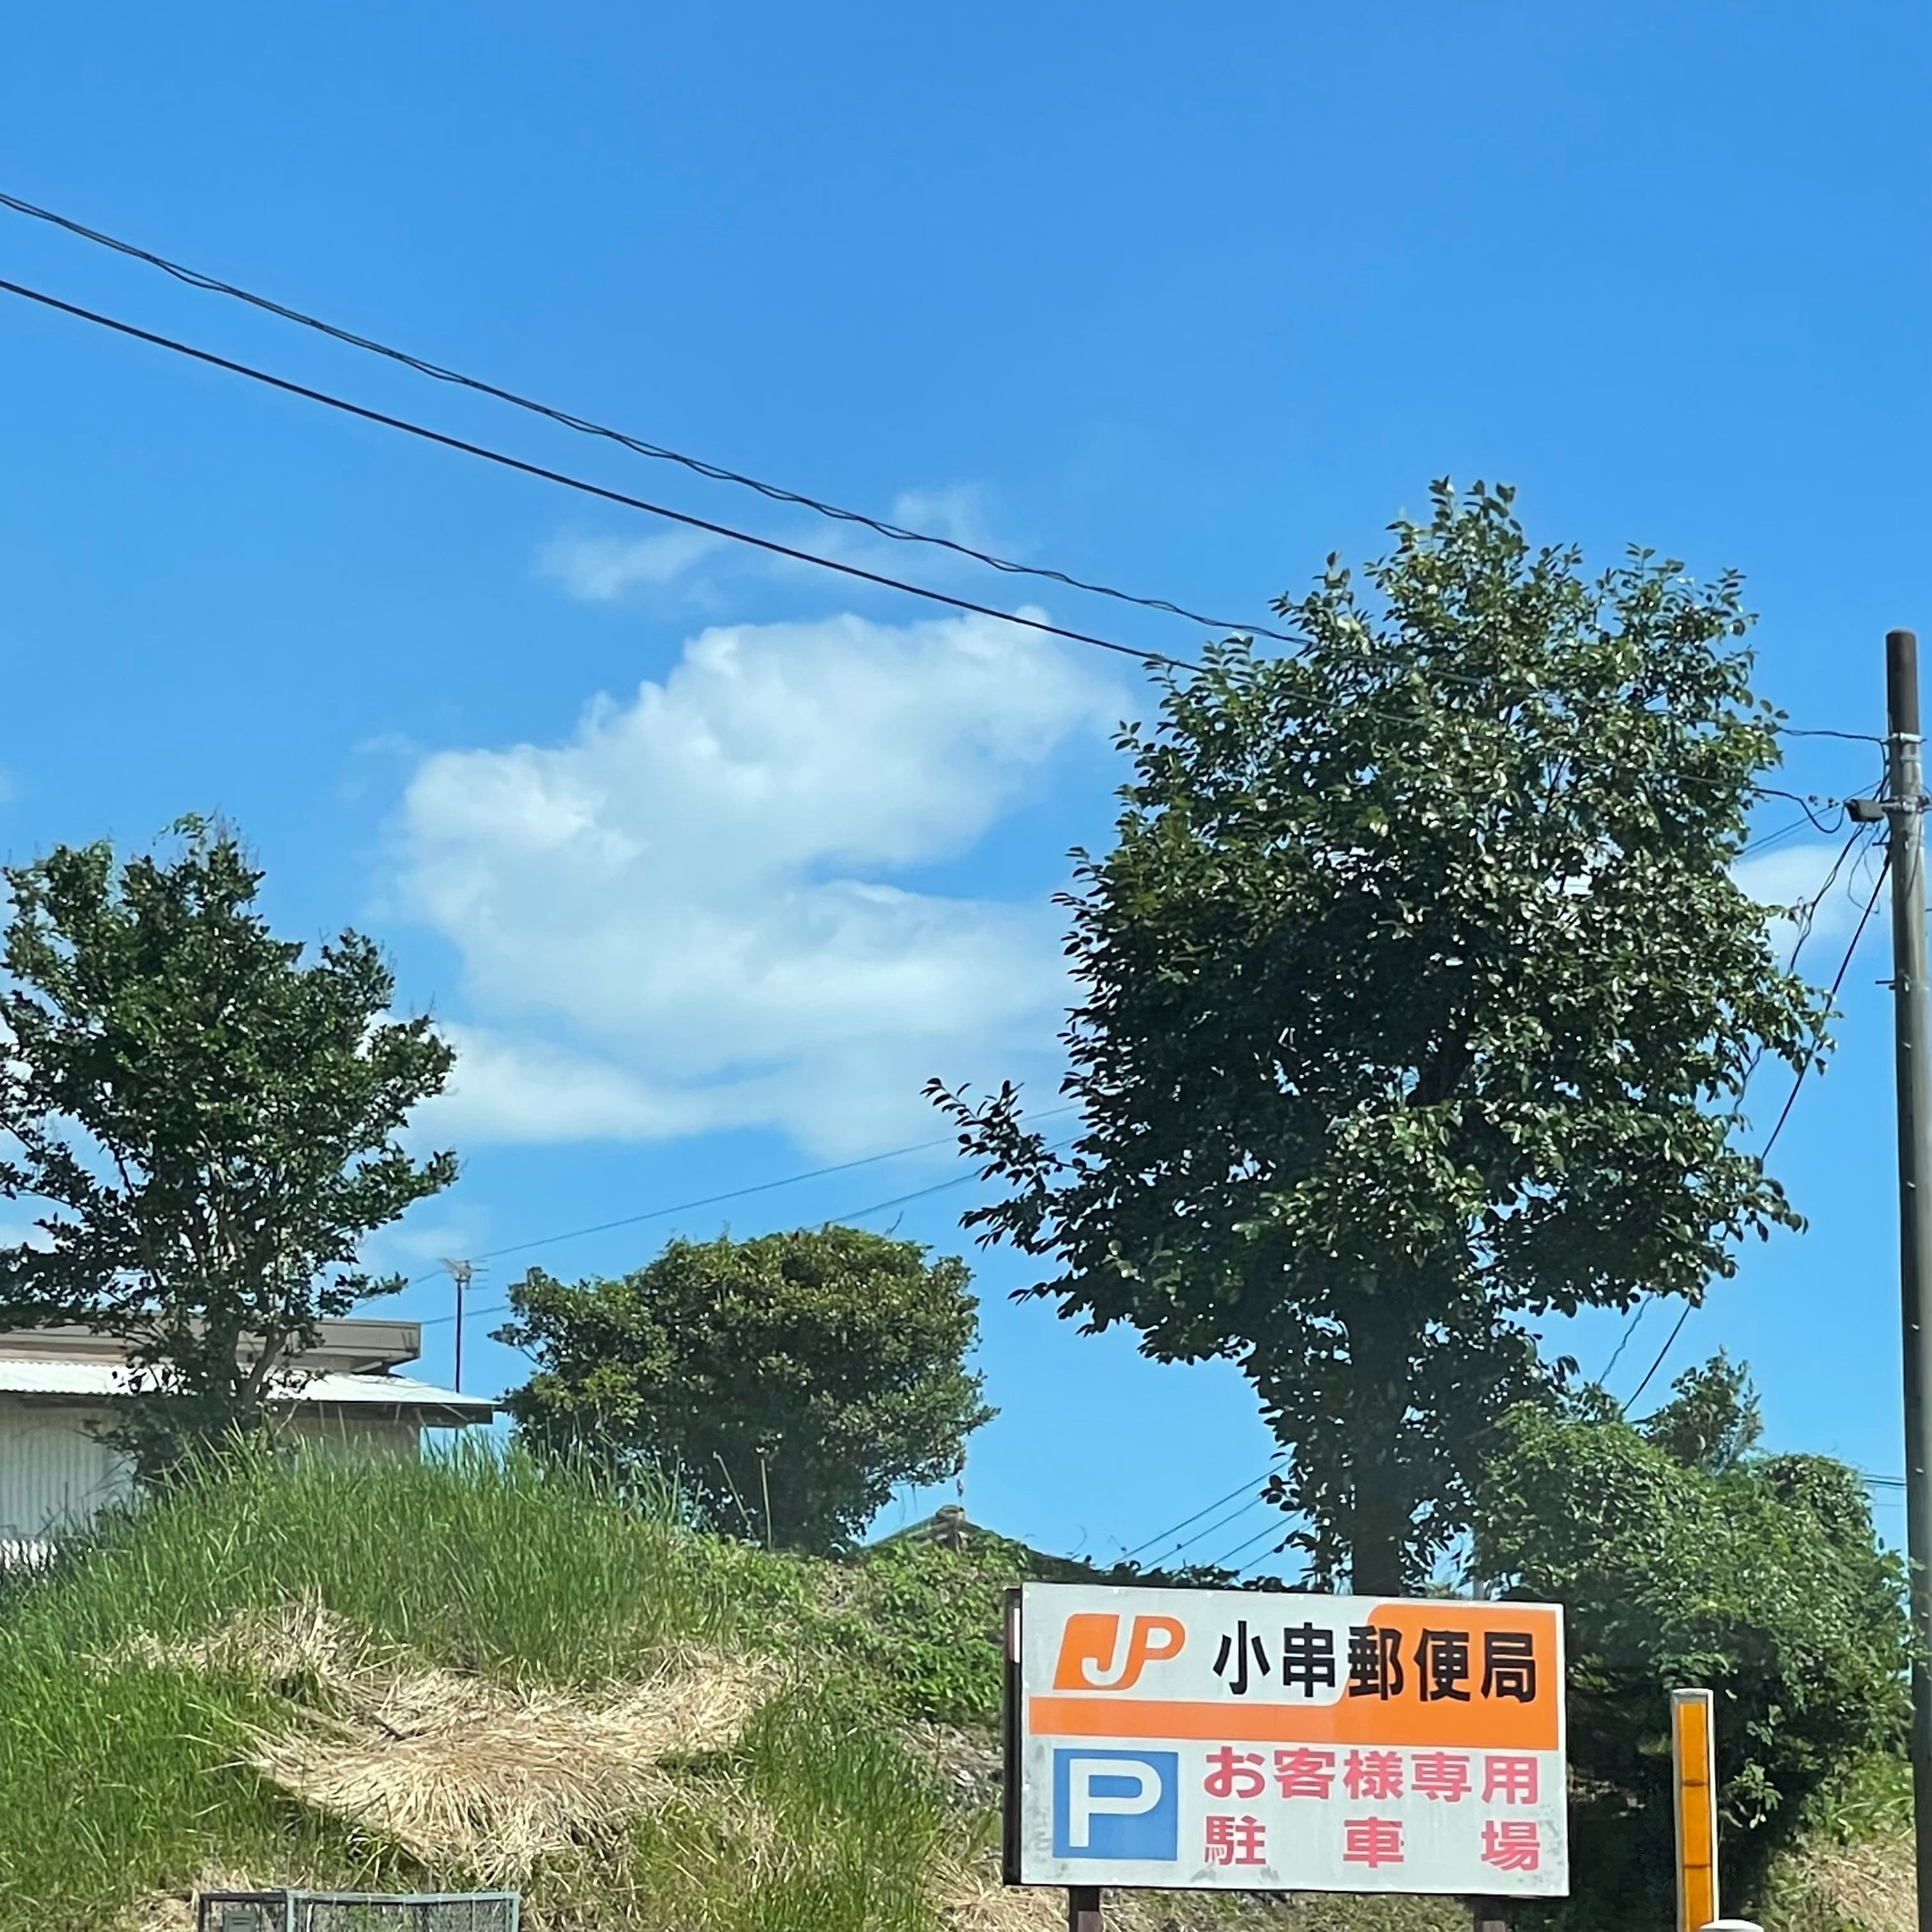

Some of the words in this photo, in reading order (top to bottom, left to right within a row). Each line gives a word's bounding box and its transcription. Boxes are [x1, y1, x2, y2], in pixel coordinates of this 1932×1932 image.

[1081, 1614, 1186, 1687] JP
[1213, 1620, 1536, 1703] 小串郵便局
[1069, 1758, 1163, 1848] P
[1203, 1745, 1539, 1805] お客様専用
[1204, 1815, 1540, 1872] 駐車場
